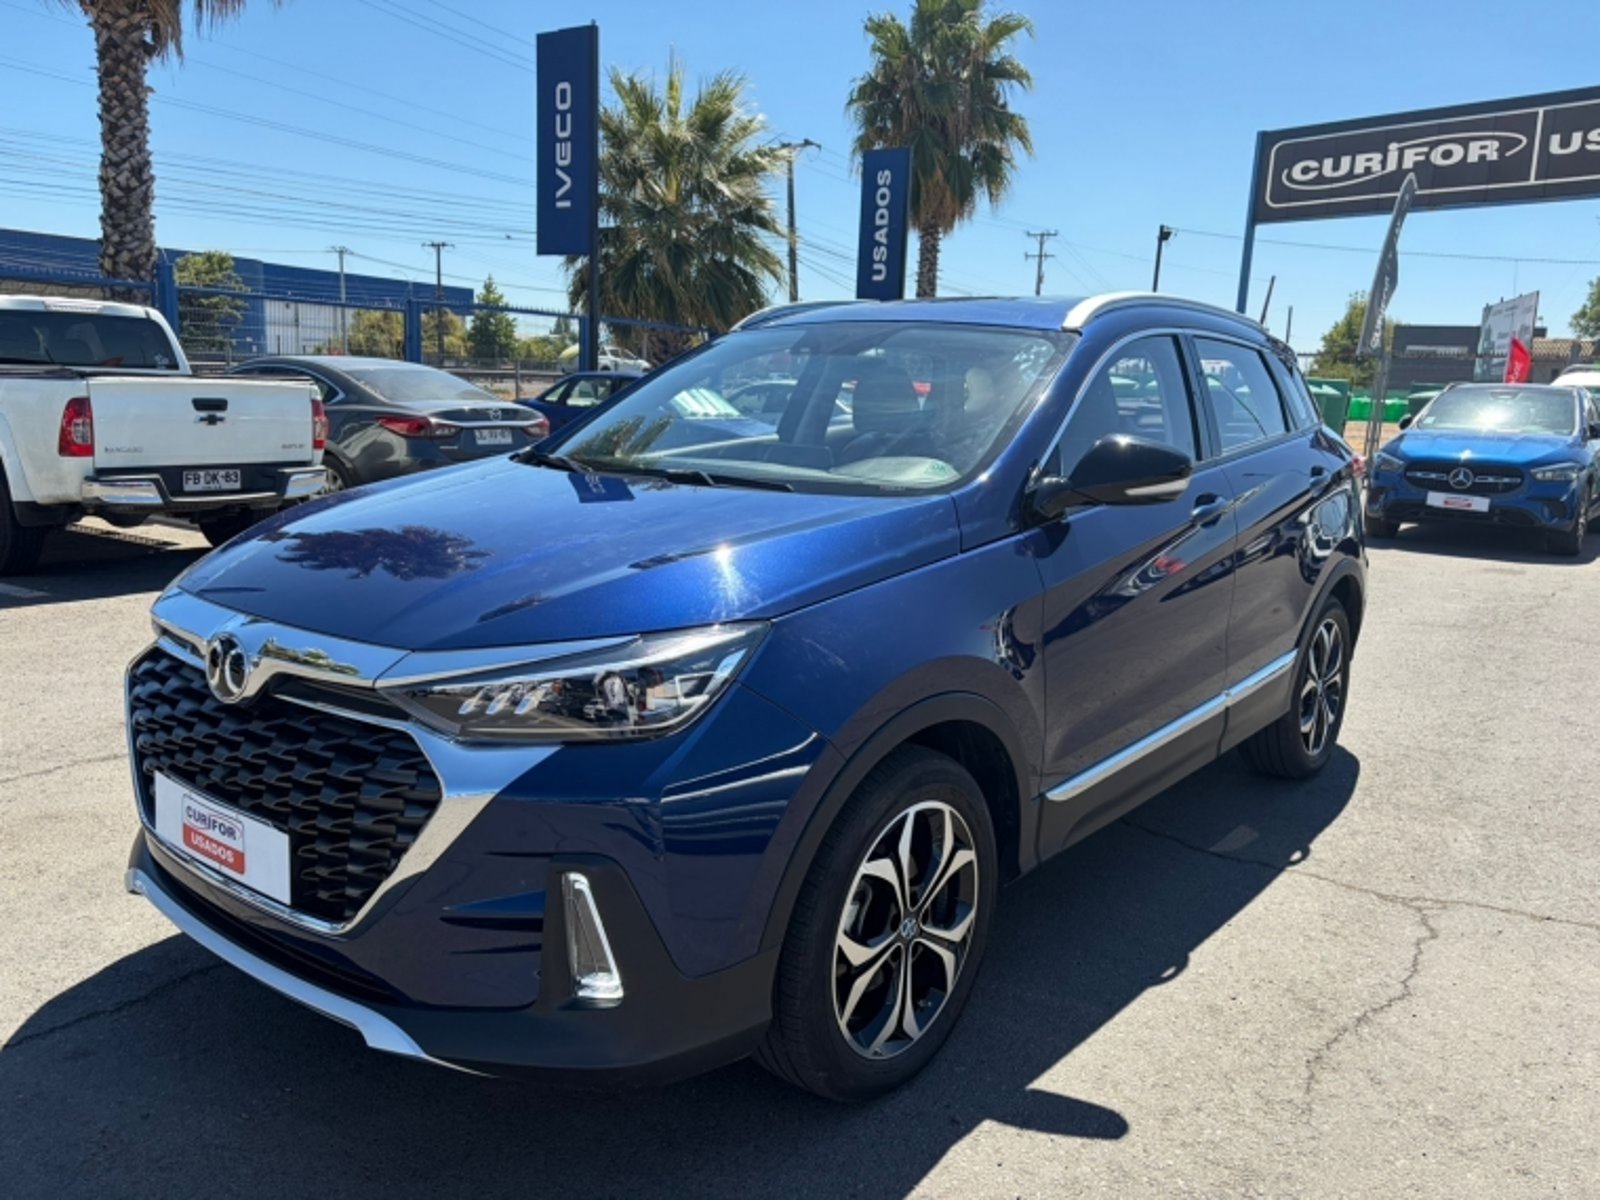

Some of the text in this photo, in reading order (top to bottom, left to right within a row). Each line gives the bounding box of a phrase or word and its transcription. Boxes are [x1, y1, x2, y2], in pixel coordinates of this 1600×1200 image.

[555, 81, 572, 209] IVECO
[871, 168, 892, 282] USADOS
[184, 472, 201, 485] FB
[190, 831, 235, 863] USADOS
